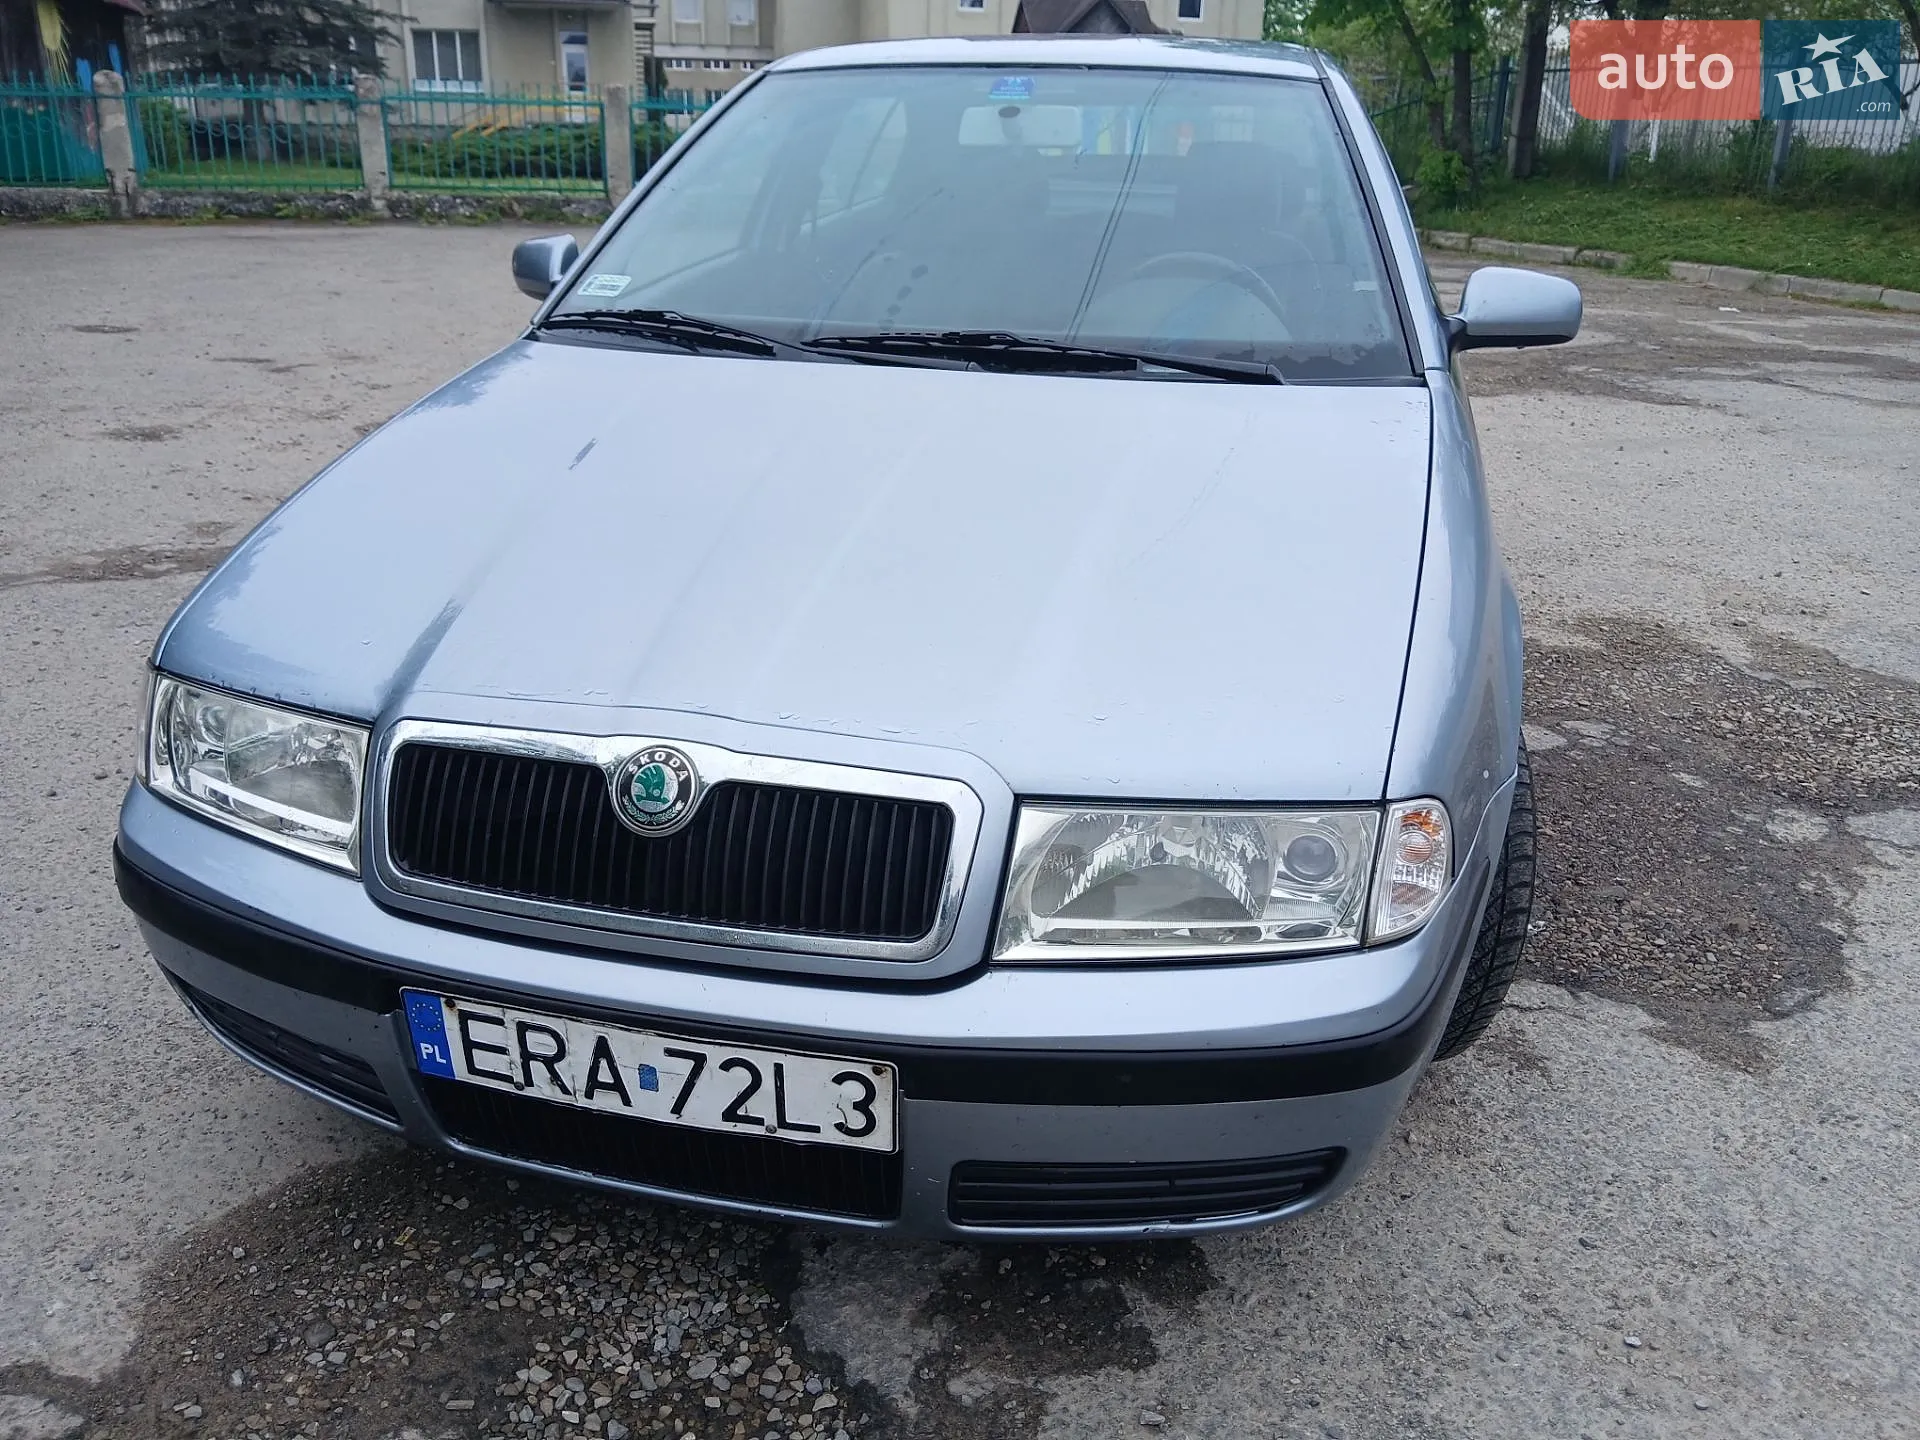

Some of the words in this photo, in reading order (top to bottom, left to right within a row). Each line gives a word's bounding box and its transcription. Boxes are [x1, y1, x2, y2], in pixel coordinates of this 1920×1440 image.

[420, 1042, 448, 1064] PL
[459, 1010, 633, 1108] ERA
[663, 1047, 877, 1137] 72L3
